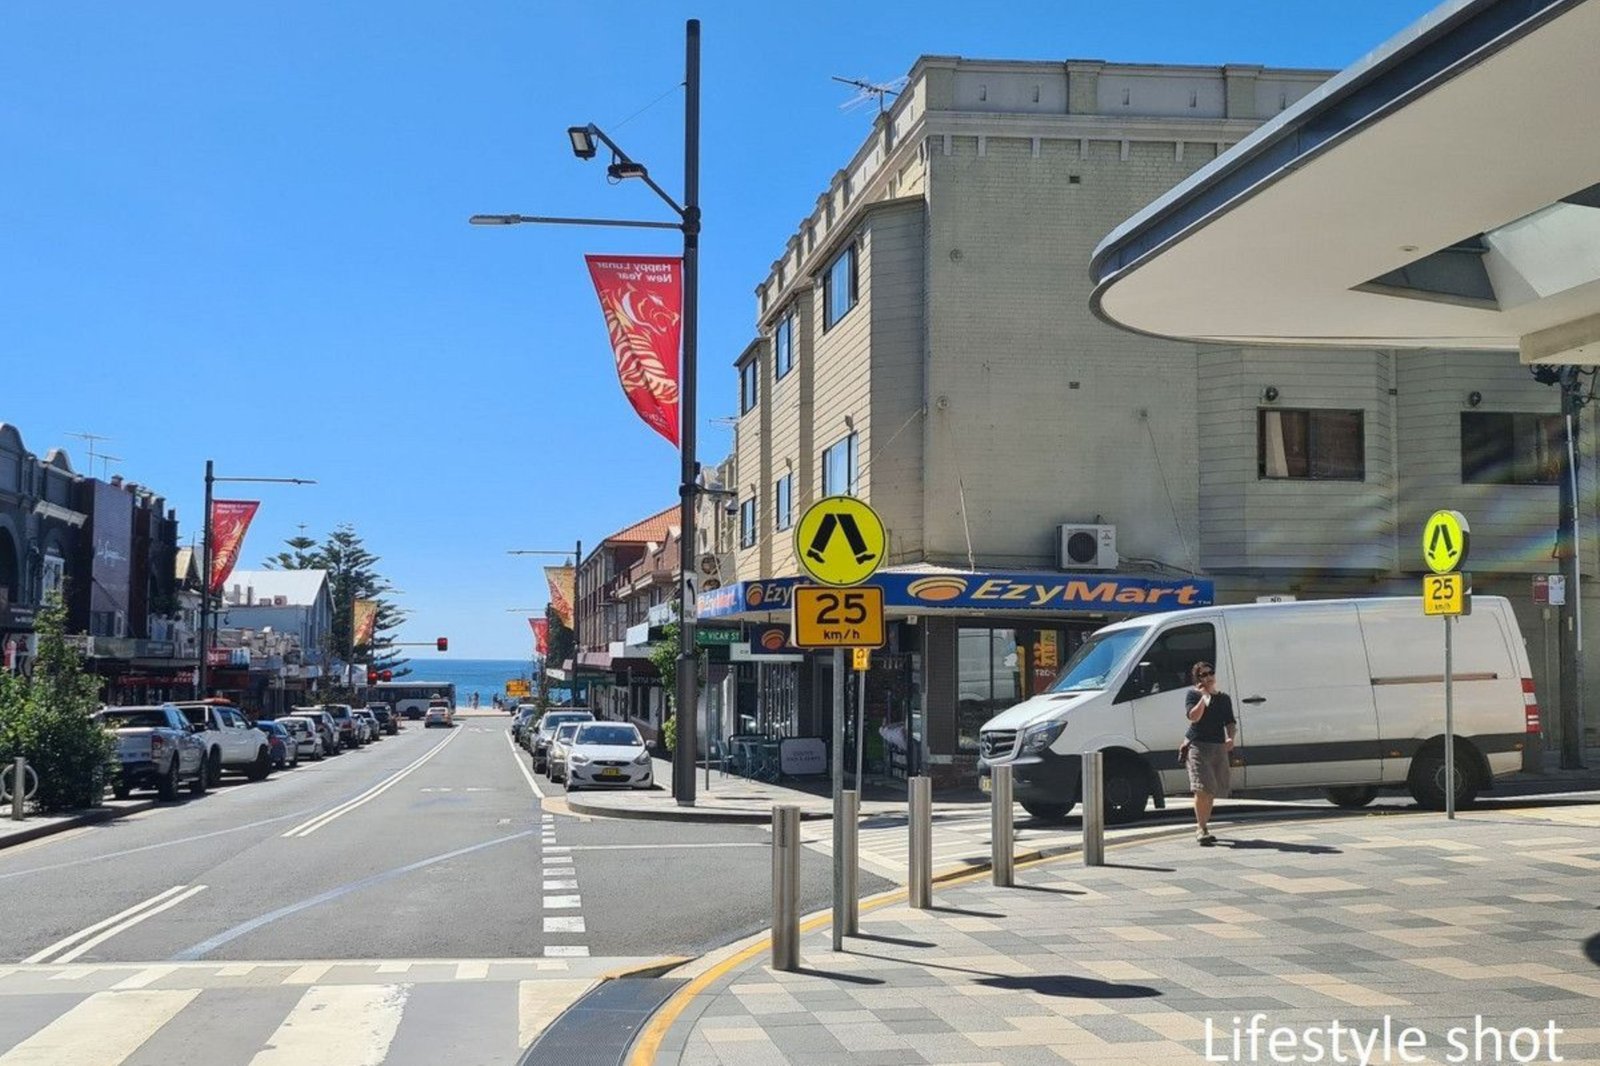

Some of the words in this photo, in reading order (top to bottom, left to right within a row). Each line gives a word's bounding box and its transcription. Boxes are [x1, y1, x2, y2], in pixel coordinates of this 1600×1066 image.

[764, 583, 806, 606] Ezy
[970, 579, 1199, 606] EzyMart
[1432, 578, 1455, 600] 25
[816, 593, 867, 625] 25
[708, 631, 729, 641] VICAR
[823, 629, 860, 640] km/h
